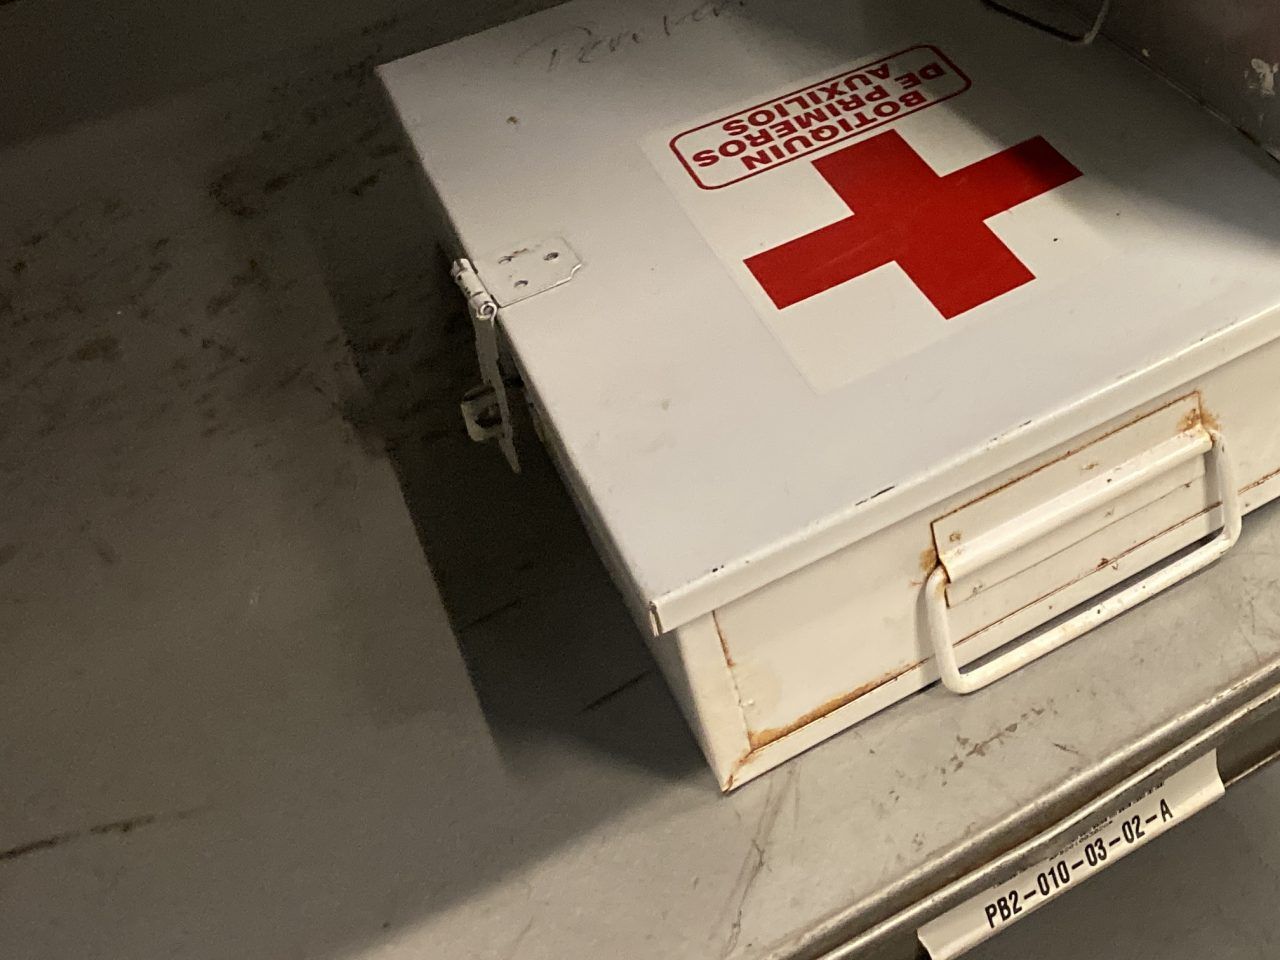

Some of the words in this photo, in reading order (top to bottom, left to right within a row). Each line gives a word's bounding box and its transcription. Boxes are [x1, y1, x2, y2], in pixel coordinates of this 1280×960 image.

[722, 62, 891, 136] AUXILIOS
[893, 62, 948, 90] DE
[692, 85, 891, 168] PRIMEROS
[741, 90, 928, 170] BOTIQUIN
[985, 798, 1173, 929] PB2-010-03-02-A
